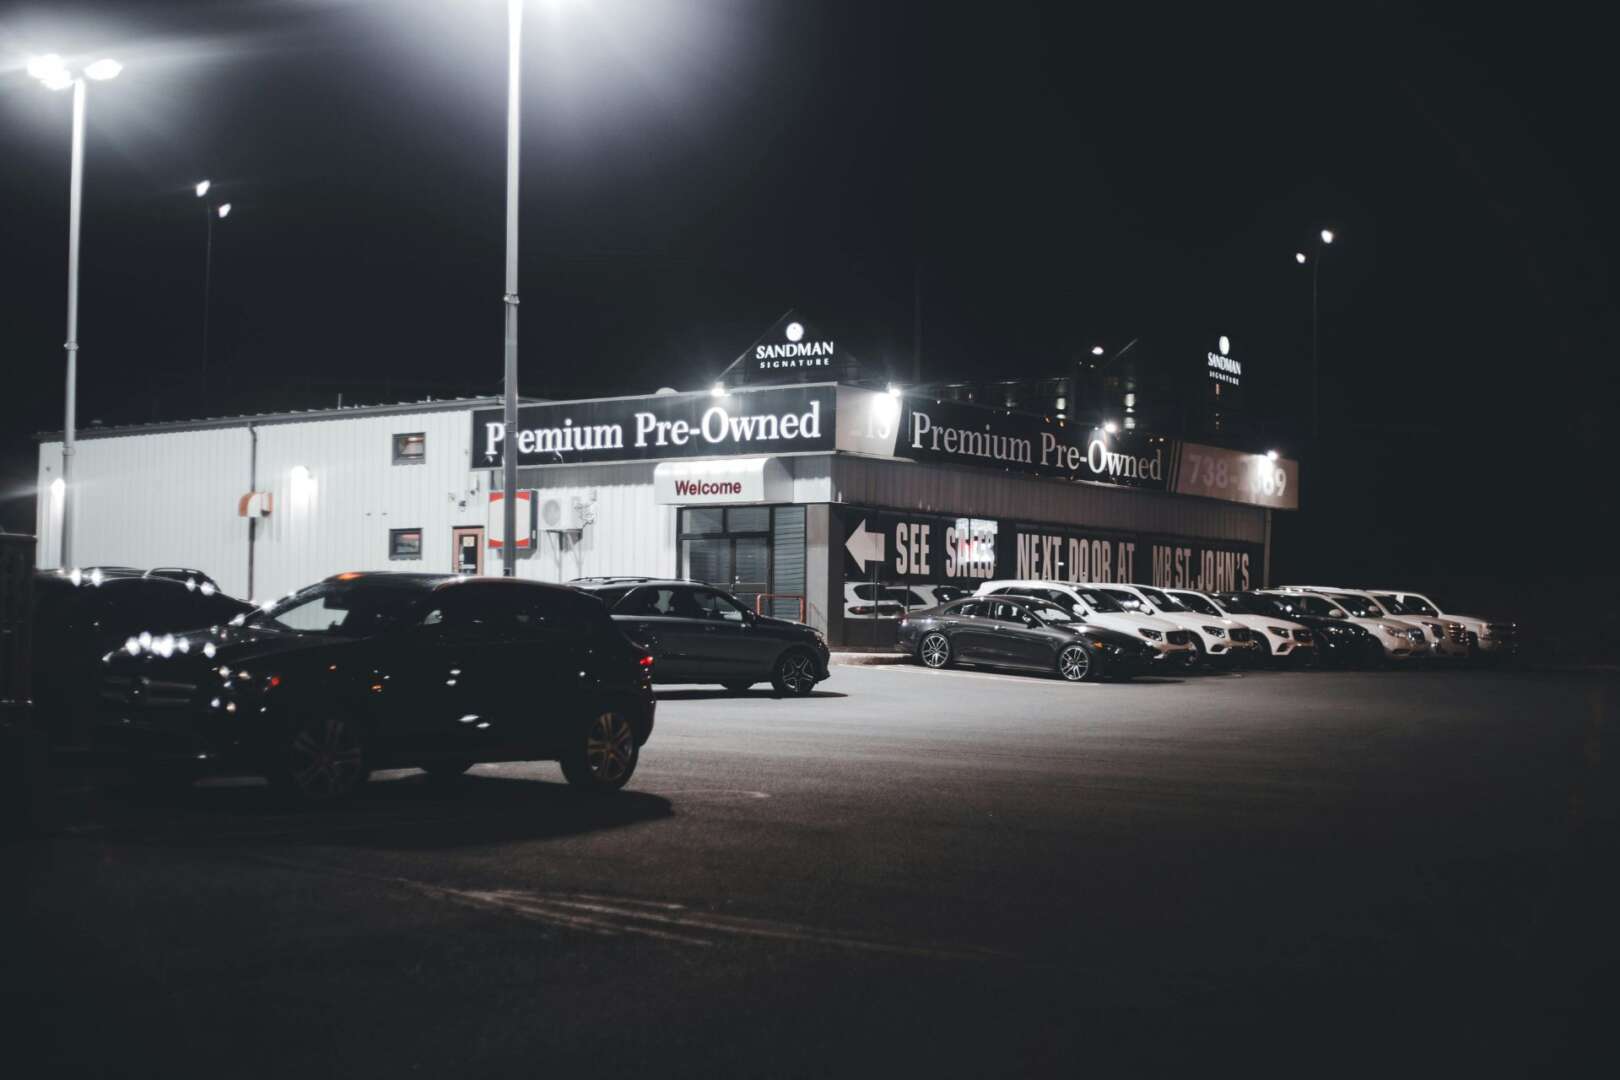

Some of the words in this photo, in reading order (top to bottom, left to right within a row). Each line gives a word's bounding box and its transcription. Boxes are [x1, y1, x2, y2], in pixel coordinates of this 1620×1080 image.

[756, 341, 834, 359] SANDMAN
[760, 358, 830, 369] SIGNATURE
[1208, 351, 1241, 375] SANDMAN
[485, 419, 624, 456] Pemium
[634, 400, 822, 448] Pre-Owned
[911, 411, 1032, 464] Premium
[1040, 432, 1163, 480] Pre-Owned
[675, 480, 742, 496] Welcome
[1189, 454, 1287, 497] 738-69
[896, 522, 930, 575] SEE
[1017, 533, 1062, 581] NEXT
[1069, 538, 1111, 583] DOOR
[1117, 542, 1134, 584] AT
[1153, 545, 1171, 587] MB
[1198, 550, 1249, 592] JOHN'S
